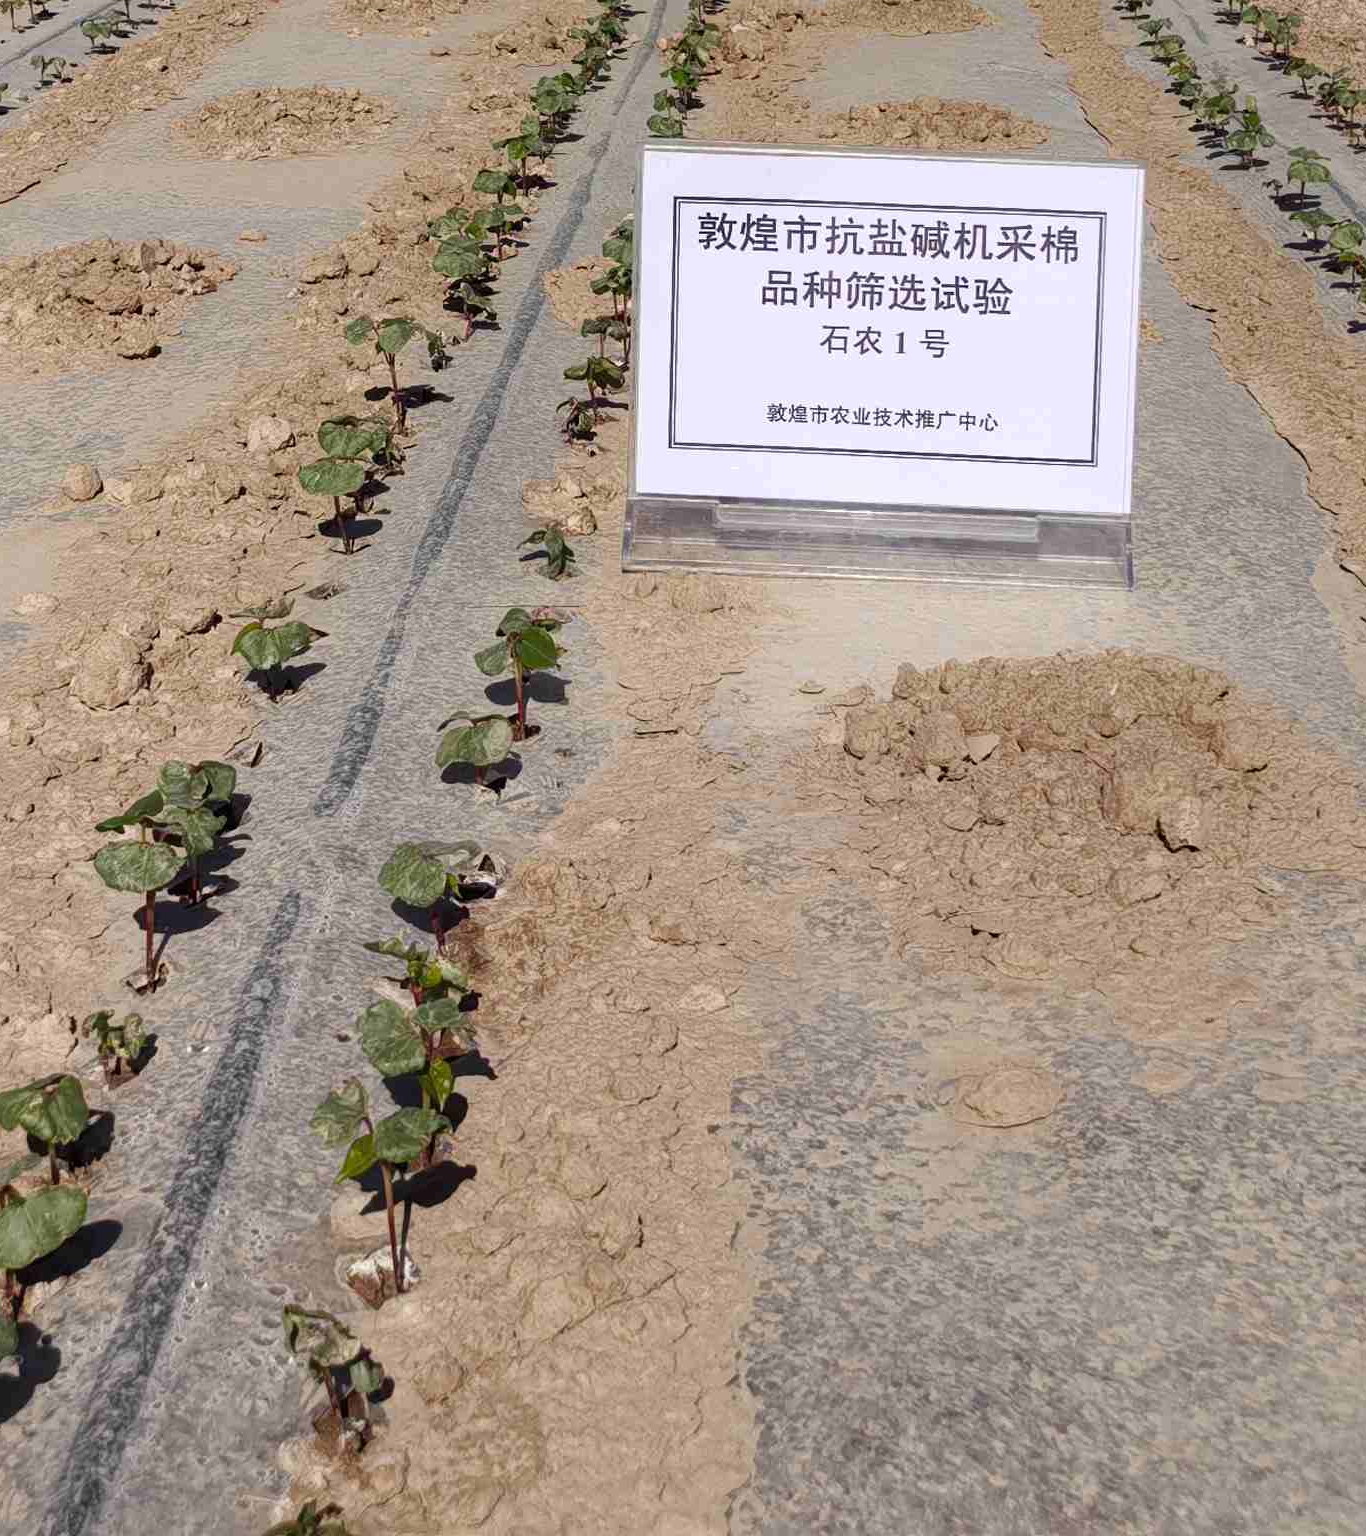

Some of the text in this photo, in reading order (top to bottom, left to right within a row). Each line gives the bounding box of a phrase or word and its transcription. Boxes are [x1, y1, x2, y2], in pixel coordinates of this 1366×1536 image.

[697, 212, 1080, 265] 敦煌市抗盐碱机采棉
[761, 269, 1014, 316] 品种筛选试验
[766, 402, 999, 432] 敦煌市农业技术推广中心
